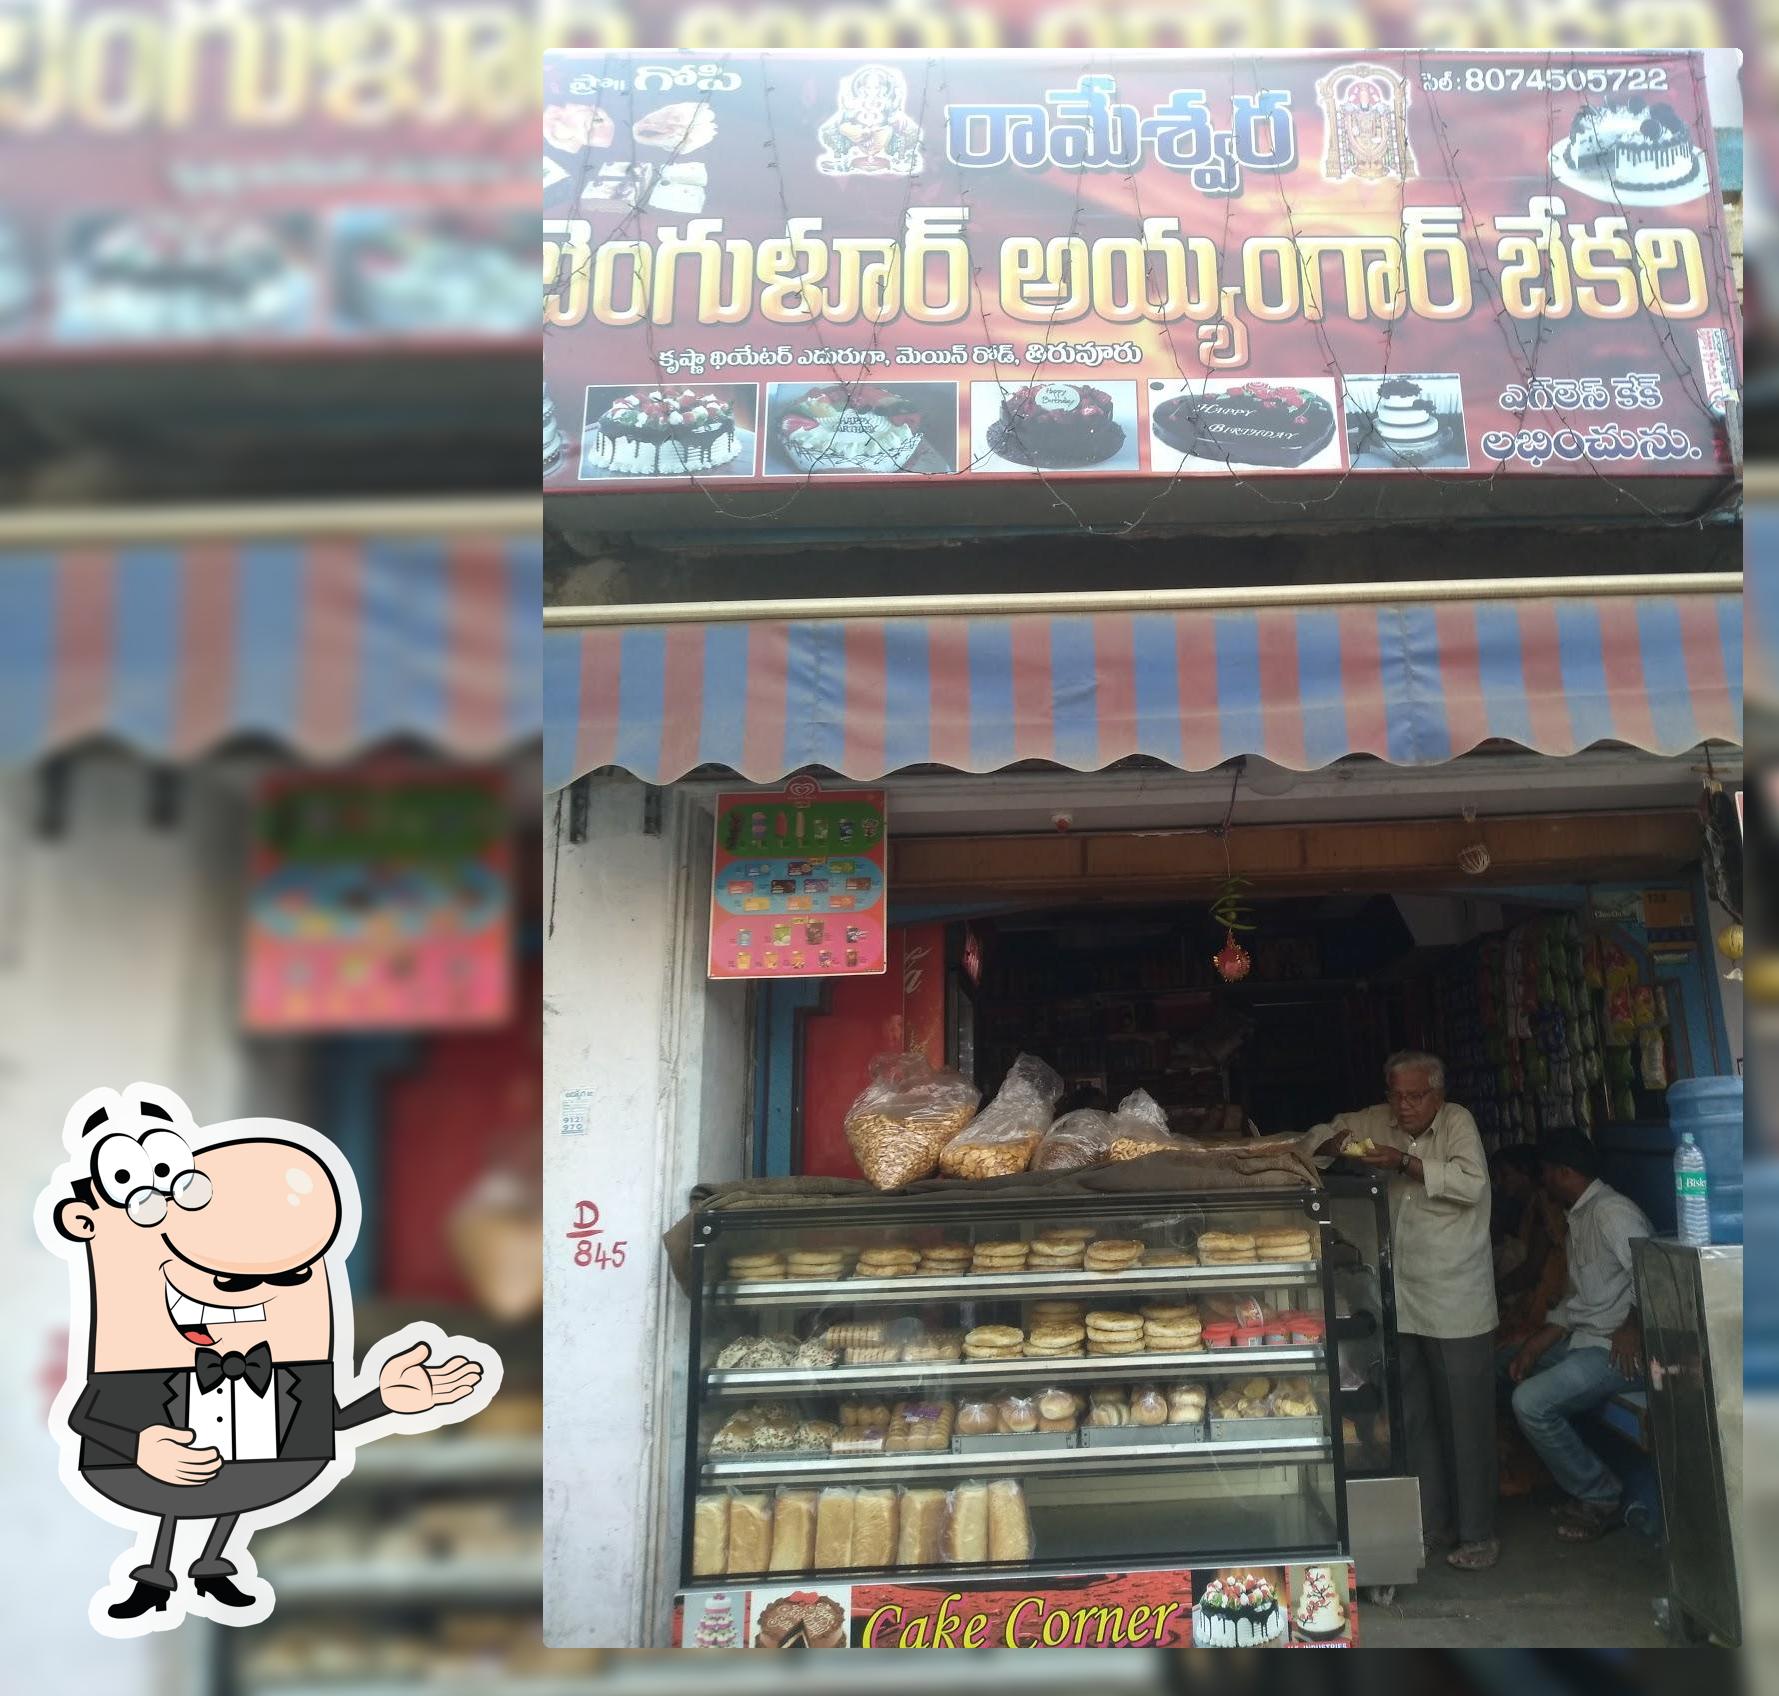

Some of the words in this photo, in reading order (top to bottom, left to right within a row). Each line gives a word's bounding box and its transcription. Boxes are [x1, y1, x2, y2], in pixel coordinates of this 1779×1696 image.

[634, 64, 742, 91] గోపి
[1465, 67, 1669, 92] 8074505722
[944, 74, 1296, 192] రామేశ్వర
[658, 347, 706, 374] కృష్ణా
[1612, 373, 1663, 410] కేక్
[573, 1200, 600, 1230] D
[574, 1238, 628, 1270] 845
[861, 1593, 989, 1648] Cake
[1004, 1596, 1180, 1648] Corner
